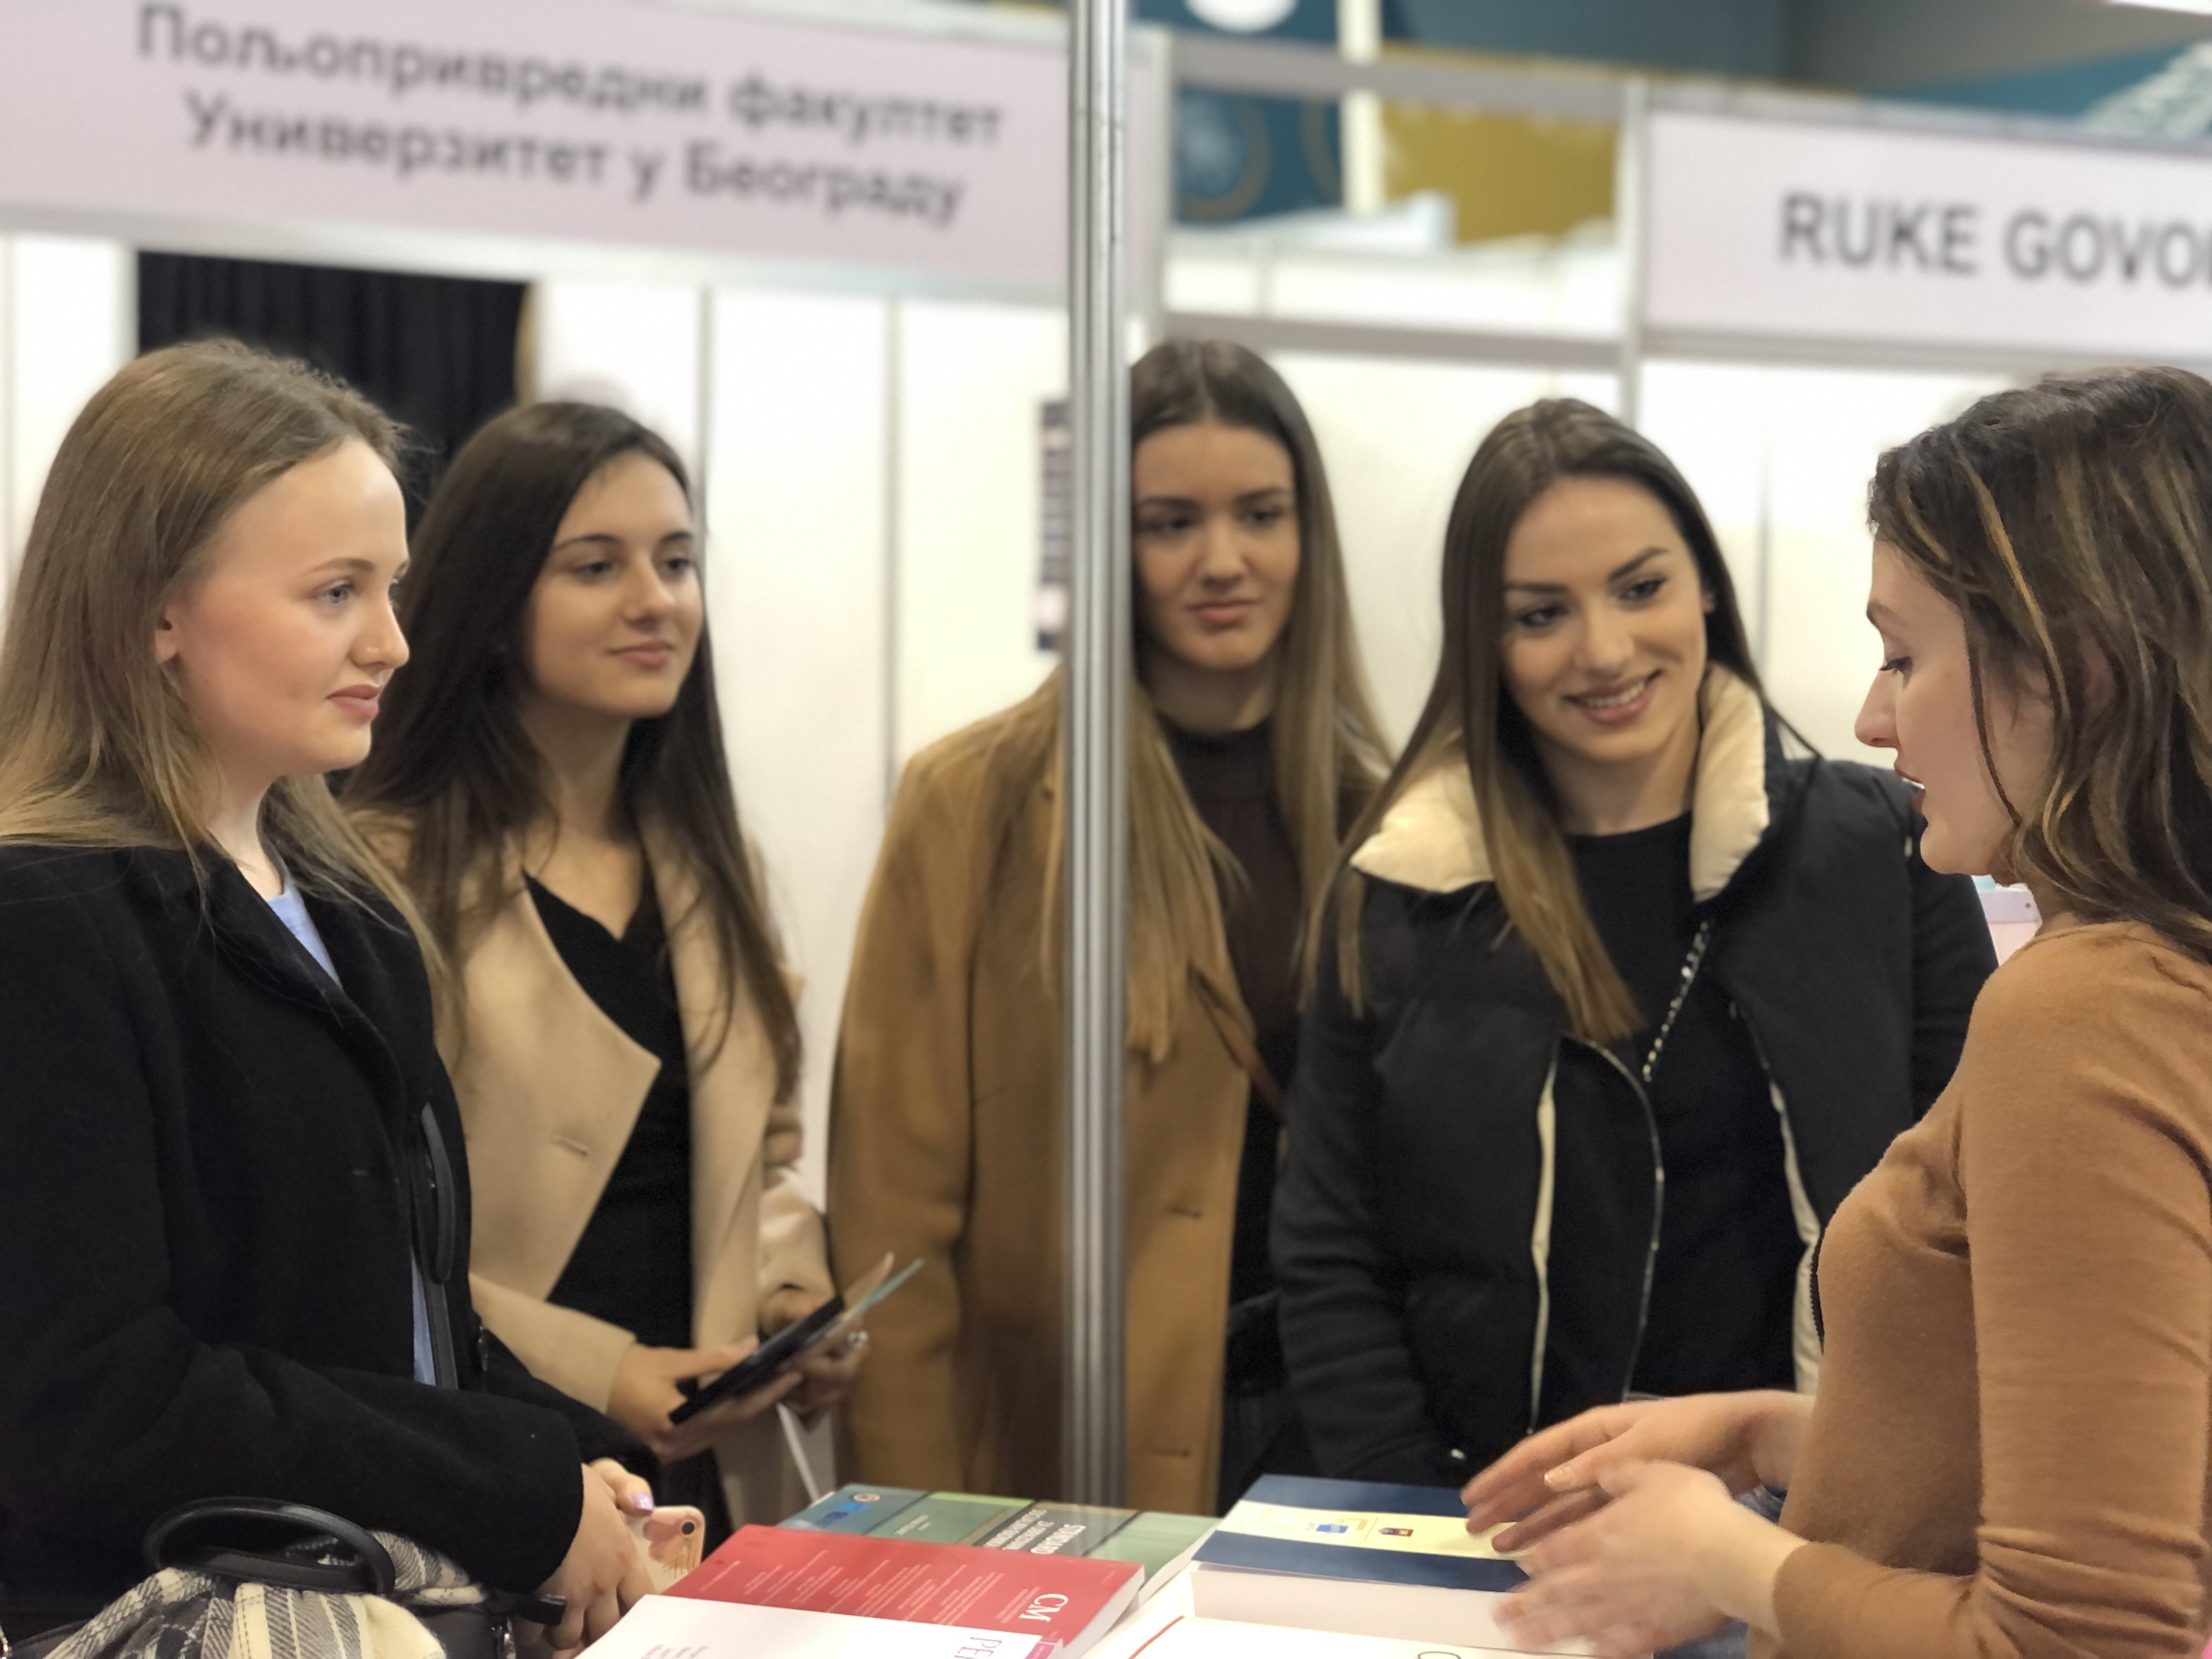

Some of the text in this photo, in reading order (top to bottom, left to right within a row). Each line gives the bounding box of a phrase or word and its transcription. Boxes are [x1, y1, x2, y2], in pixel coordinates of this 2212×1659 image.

[137, 1, 1001, 145] Пољопривредни факултет
[185, 93, 963, 228] Универзитет у Београду
[1779, 191, 2212, 290] RUKE GOVO
[1018, 1593, 1069, 1622] CM
